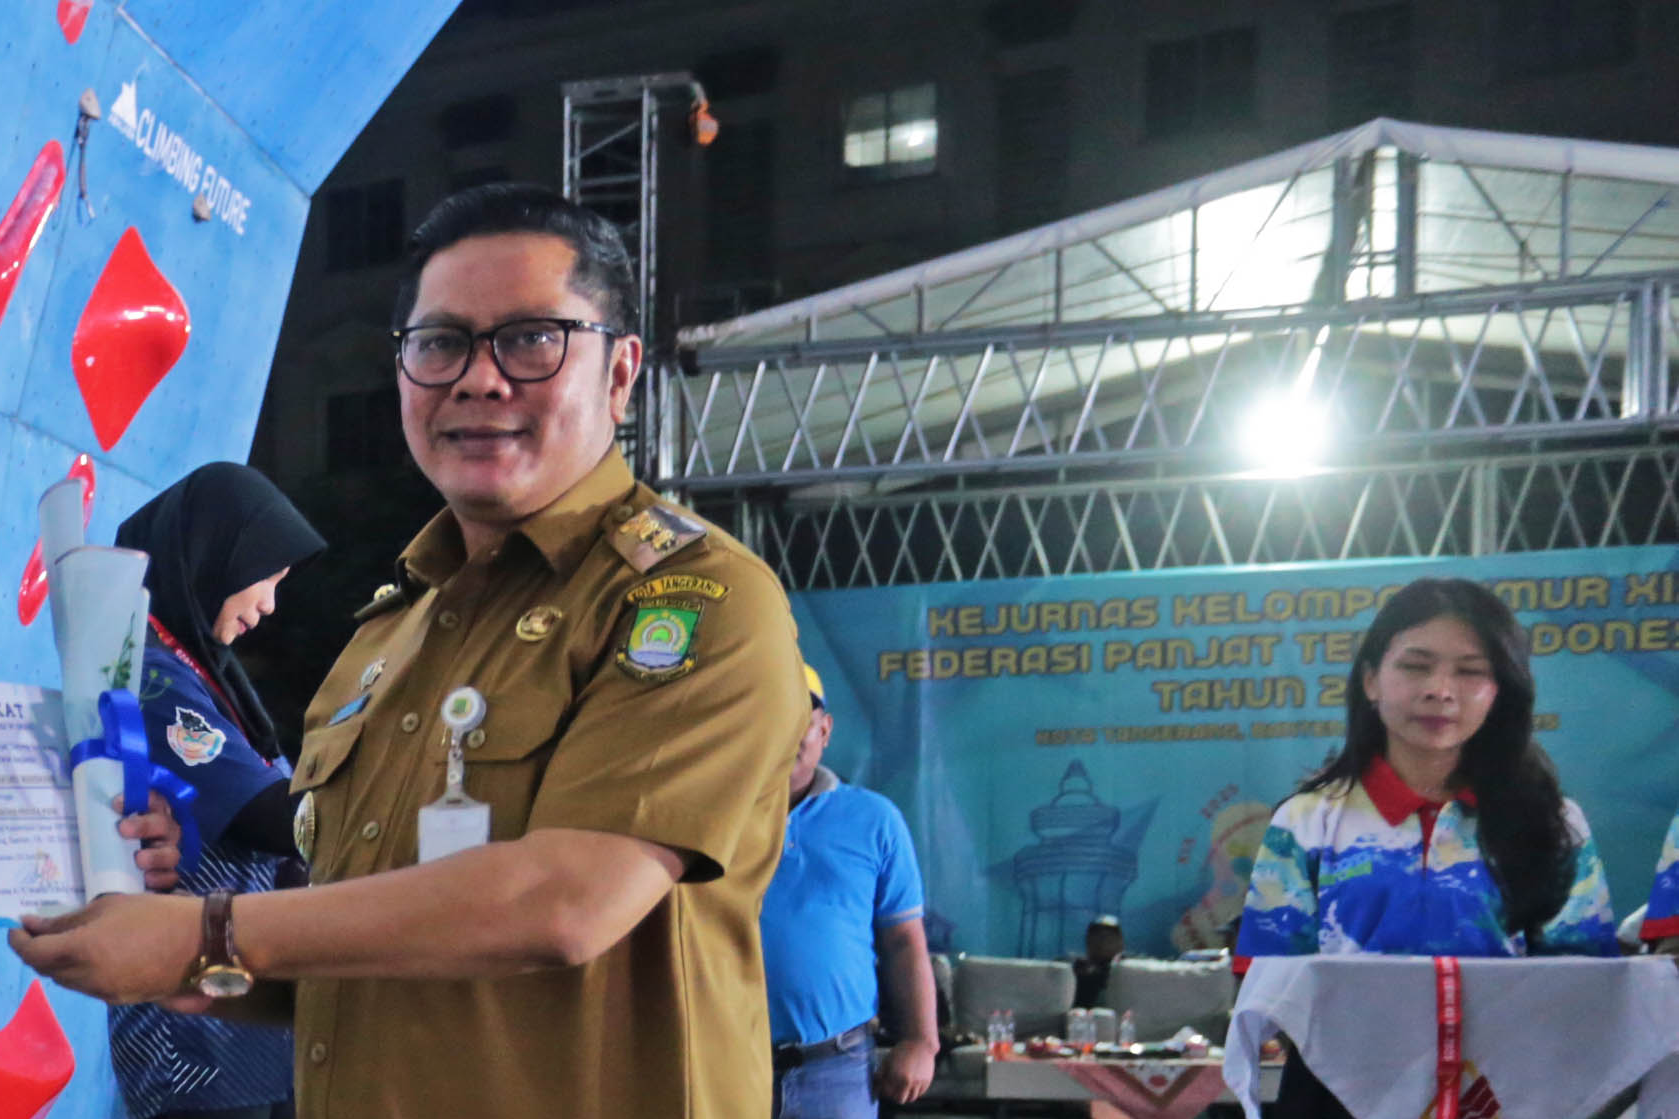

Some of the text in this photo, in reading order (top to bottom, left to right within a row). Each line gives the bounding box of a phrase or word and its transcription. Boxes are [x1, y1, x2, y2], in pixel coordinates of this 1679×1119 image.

[136, 108, 251, 236] CLIMBING FUTURE
[927, 572, 1679, 638] KEJURNAS KELOMP MUR XI
[878, 643, 1091, 681] FEDERASI
[1103, 632, 1281, 671] PANJAT
[1152, 677, 1306, 712] TAHUN
